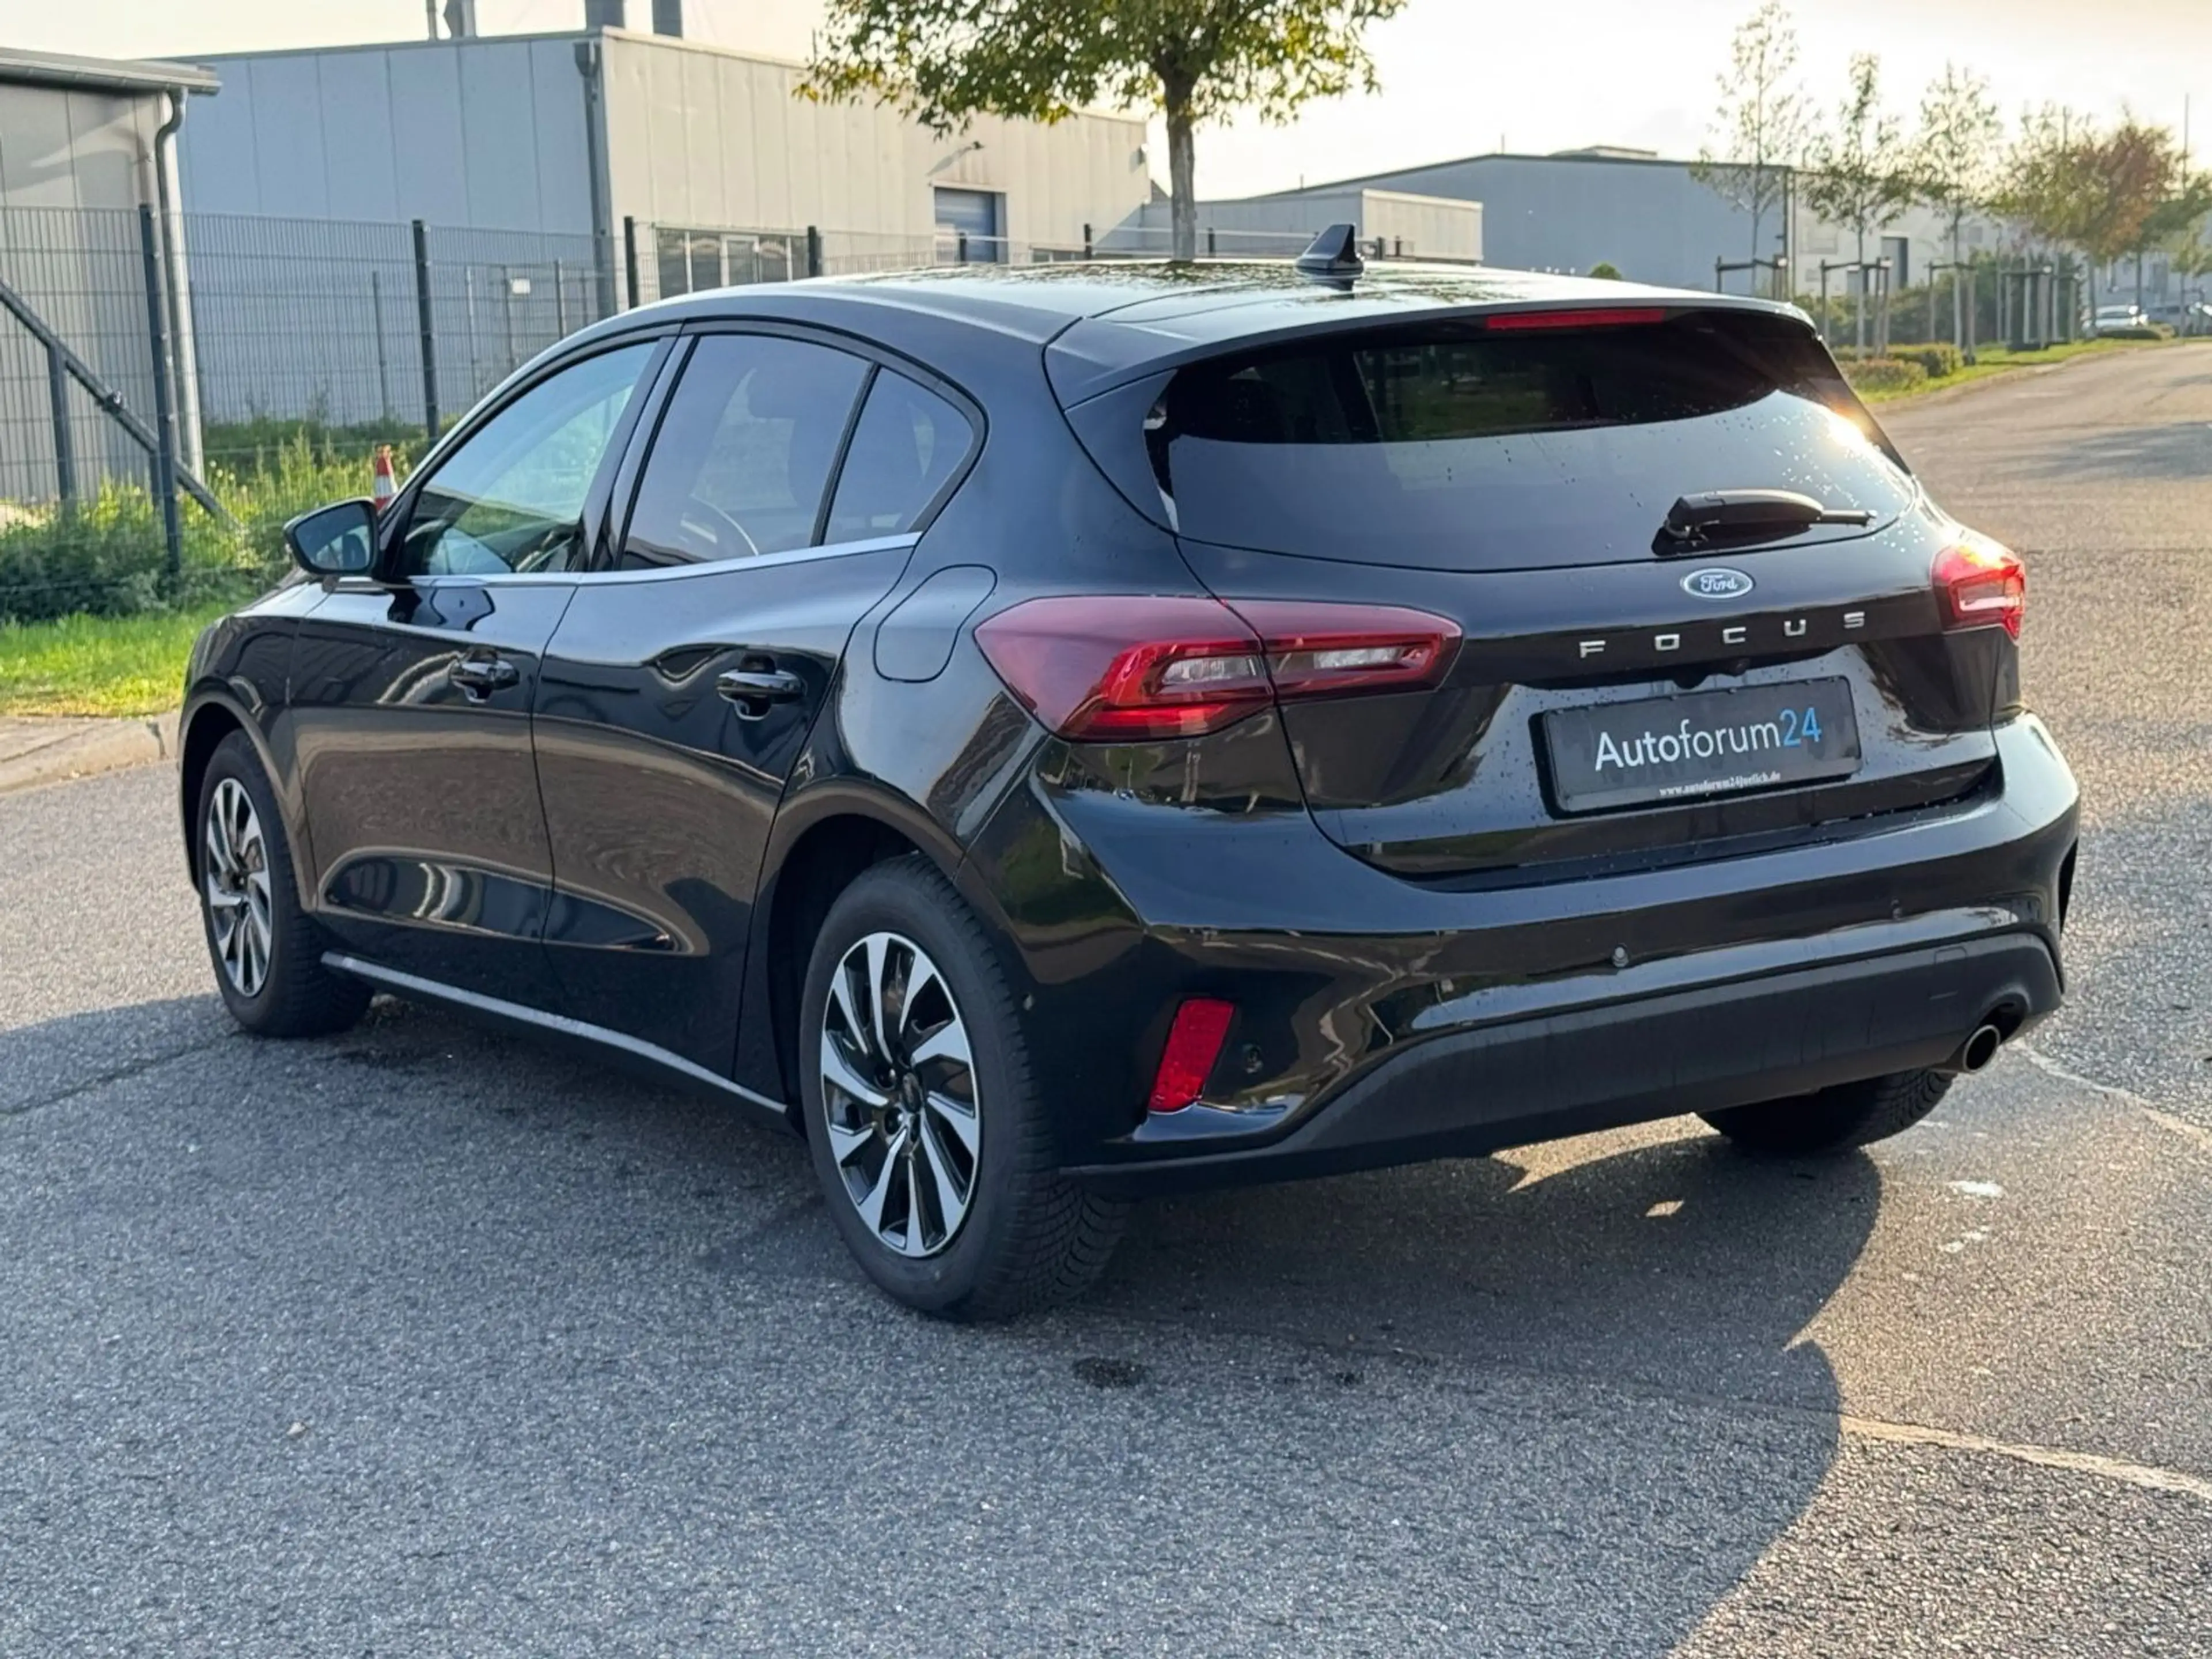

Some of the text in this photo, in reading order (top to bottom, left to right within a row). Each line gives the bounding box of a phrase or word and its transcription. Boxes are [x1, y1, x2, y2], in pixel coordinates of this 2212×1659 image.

[1700, 574, 1738, 593] Ford
[1579, 611, 1865, 658] FOCUS
[1594, 707, 1821, 771] Autoforum24
